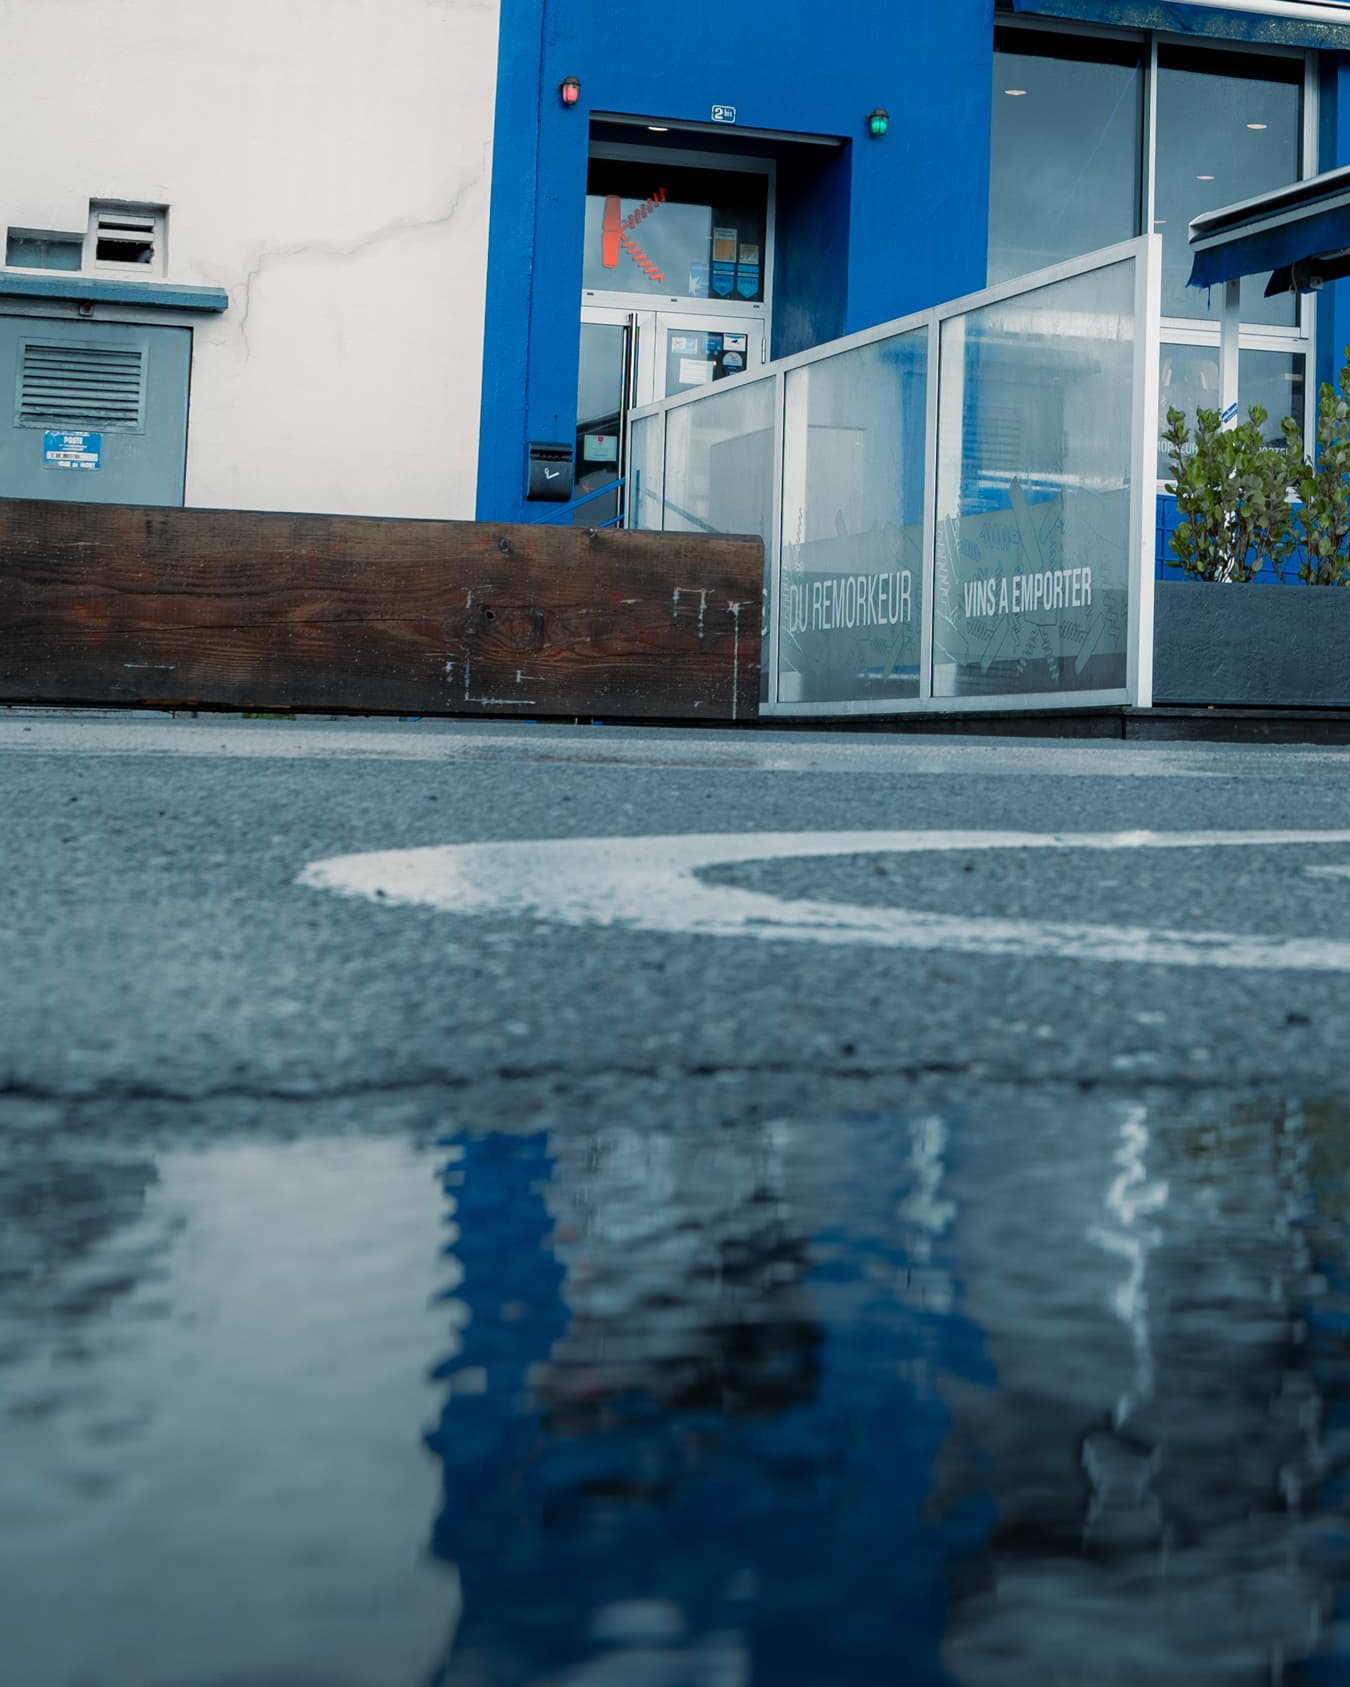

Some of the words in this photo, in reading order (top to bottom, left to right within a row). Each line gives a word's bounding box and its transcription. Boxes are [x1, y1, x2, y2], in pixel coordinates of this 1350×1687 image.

[714, 107, 724, 120] 2
[789, 584, 810, 633] DU
[813, 569, 912, 631] REMORKEUR
[964, 578, 996, 618] VINS
[998, 576, 1009, 615] A
[1012, 567, 1092, 613] EMPORTER
